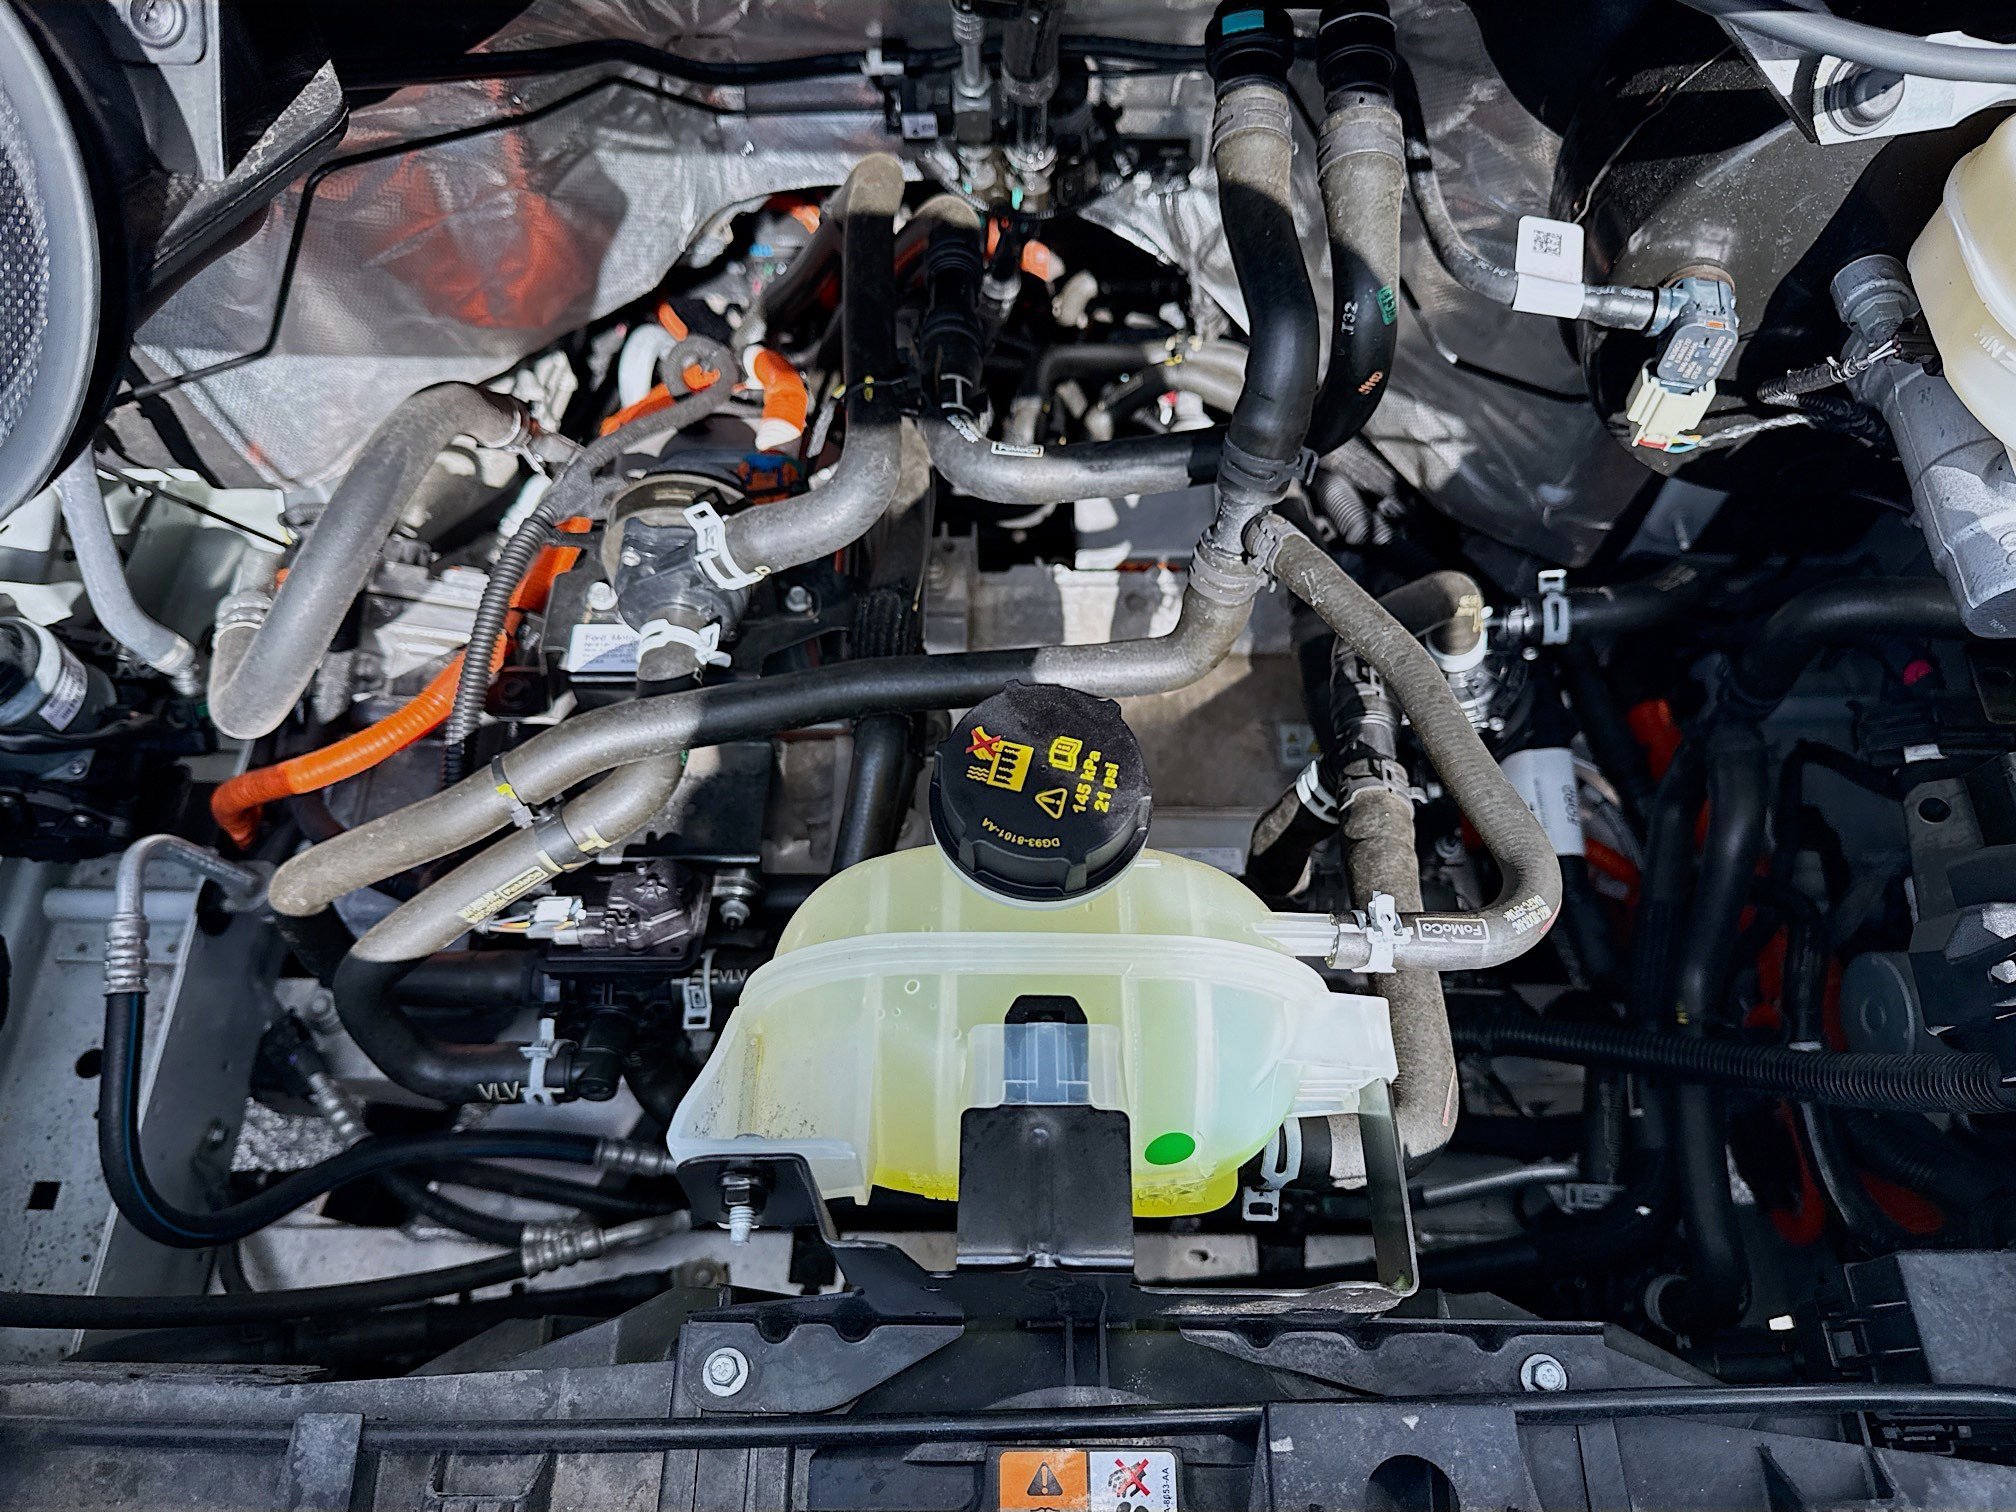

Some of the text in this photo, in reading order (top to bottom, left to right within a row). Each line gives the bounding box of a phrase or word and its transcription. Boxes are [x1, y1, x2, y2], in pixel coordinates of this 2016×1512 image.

[1072, 751, 1101, 813] 145 kPa
[1094, 762, 1119, 813] 21 psi
[981, 817, 1061, 848] DG93-8101-AA
[1424, 922, 1483, 936] FoMoCo
[719, 968, 748, 983] VLV
[477, 1080, 520, 1101] VLV
